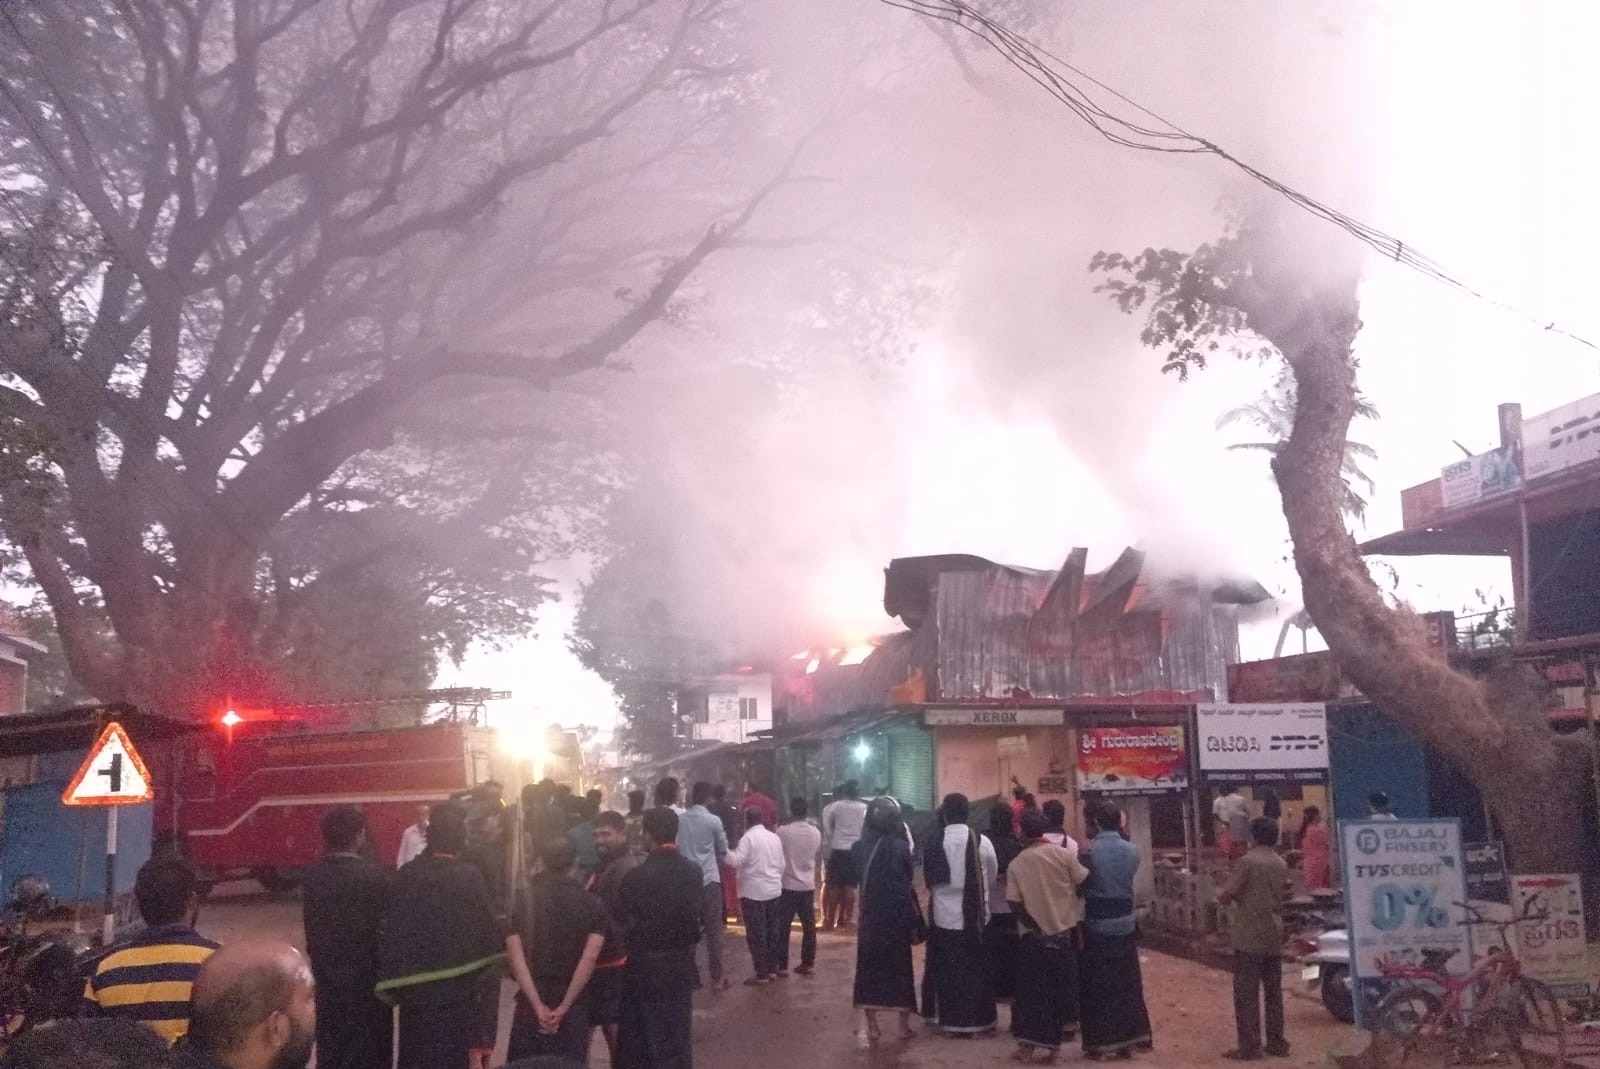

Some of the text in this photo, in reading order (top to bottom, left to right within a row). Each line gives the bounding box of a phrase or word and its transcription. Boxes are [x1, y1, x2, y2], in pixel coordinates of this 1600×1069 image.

[973, 711, 1018, 723] XEROX
[1082, 734, 1096, 754] ಶ್ರೀ
[1270, 735, 1322, 751] DTDC
[1384, 828, 1447, 840] BAJAJ
[1384, 841, 1448, 853] FINSERV
[1370, 882, 1450, 931] 0%
